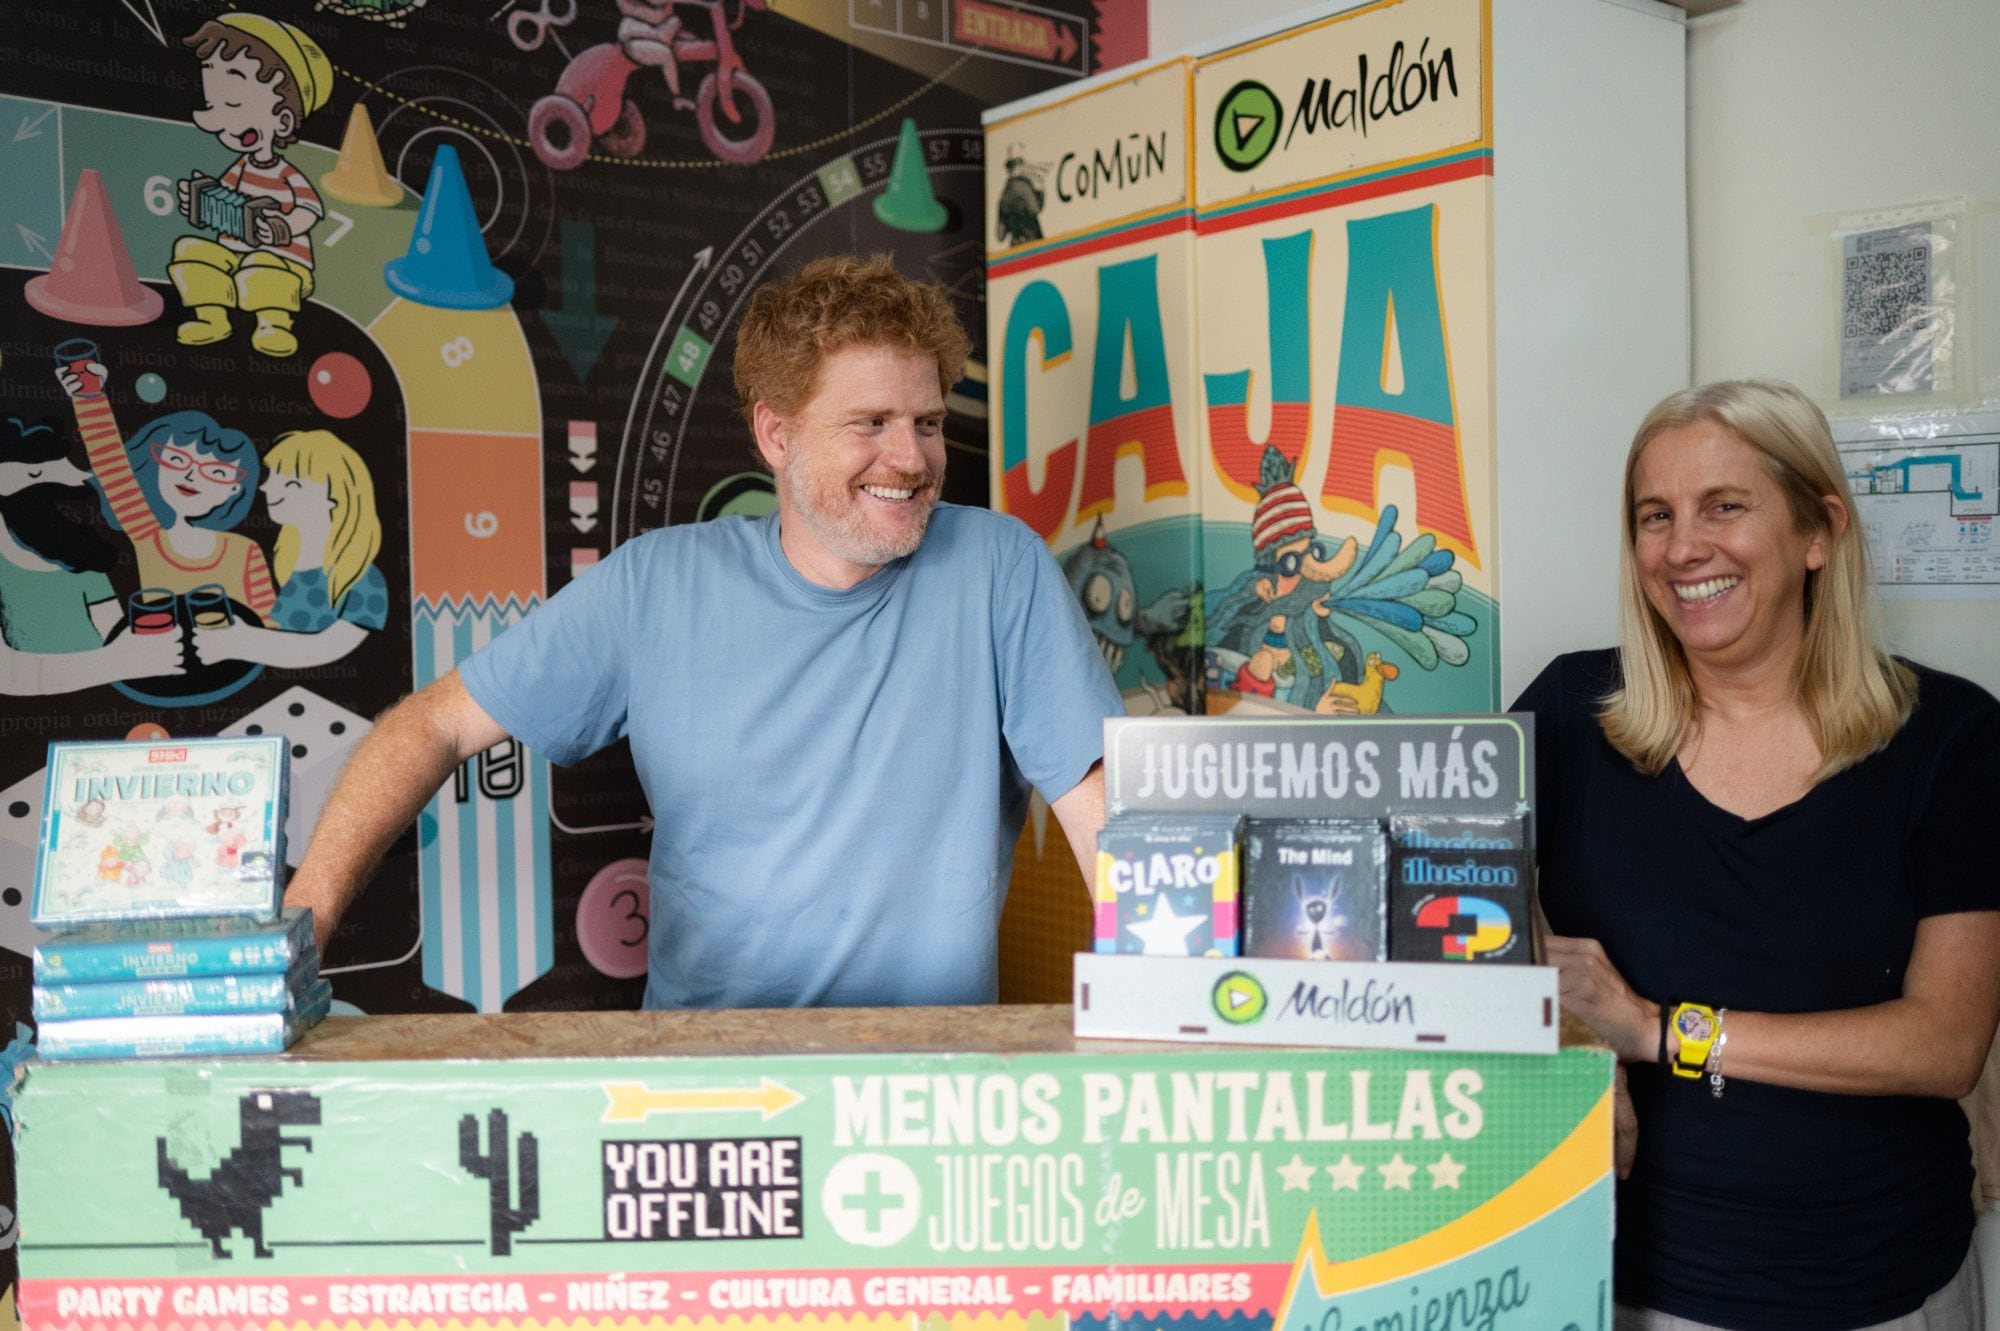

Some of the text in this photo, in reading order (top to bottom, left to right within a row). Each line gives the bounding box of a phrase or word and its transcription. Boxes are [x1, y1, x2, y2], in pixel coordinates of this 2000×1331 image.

[962, 7, 1048, 49] ENTRADA
[1284, 37, 1458, 151] Maldón
[863, 153, 888, 178] 55
[929, 140, 950, 160] 57
[143, 175, 174, 216] 6
[828, 168, 853, 194] 54
[796, 187, 822, 214] 53
[323, 209, 354, 247] 7
[766, 210, 793, 239] 52
[741, 238, 765, 267] 51
[719, 264, 744, 296] 50
[698, 300, 721, 331] 49
[441, 336, 474, 368] 8
[678, 341, 701, 373] 48
[662, 384, 682, 417] 47
[1000, 203, 1482, 571] CAJA
[650, 430, 672, 461] 46
[642, 478, 664, 510] 45
[1, 708, 71, 737] propia
[1137, 725, 1499, 800] JUGUEMOS MÁS
[74, 771, 257, 802] INVIERNO
[1278, 848, 1353, 865] The Mind
[1402, 856, 1518, 886] illusion
[1108, 852, 1220, 895] CLARO
[610, 889, 649, 947] 3
[1276, 979, 1416, 1025] Maldón
[831, 1069, 1484, 1147] MENOS PANTALLAS
[604, 1140, 800, 1189] YOU ARE
[605, 1190, 800, 1239] OFFLINE
[928, 1150, 1271, 1252] JUEGOS de MESA
[57, 1285, 163, 1318] PARTY
[171, 1284, 289, 1316] GAMES
[328, 1282, 528, 1315] ESTRATEGIA
[568, 1272, 671, 1312] NIÑEZ
[709, 1277, 855, 1309] CULTURA
[863, 1276, 1014, 1308] GENERAL
[1052, 1272, 1251, 1304] FAMILIARES
